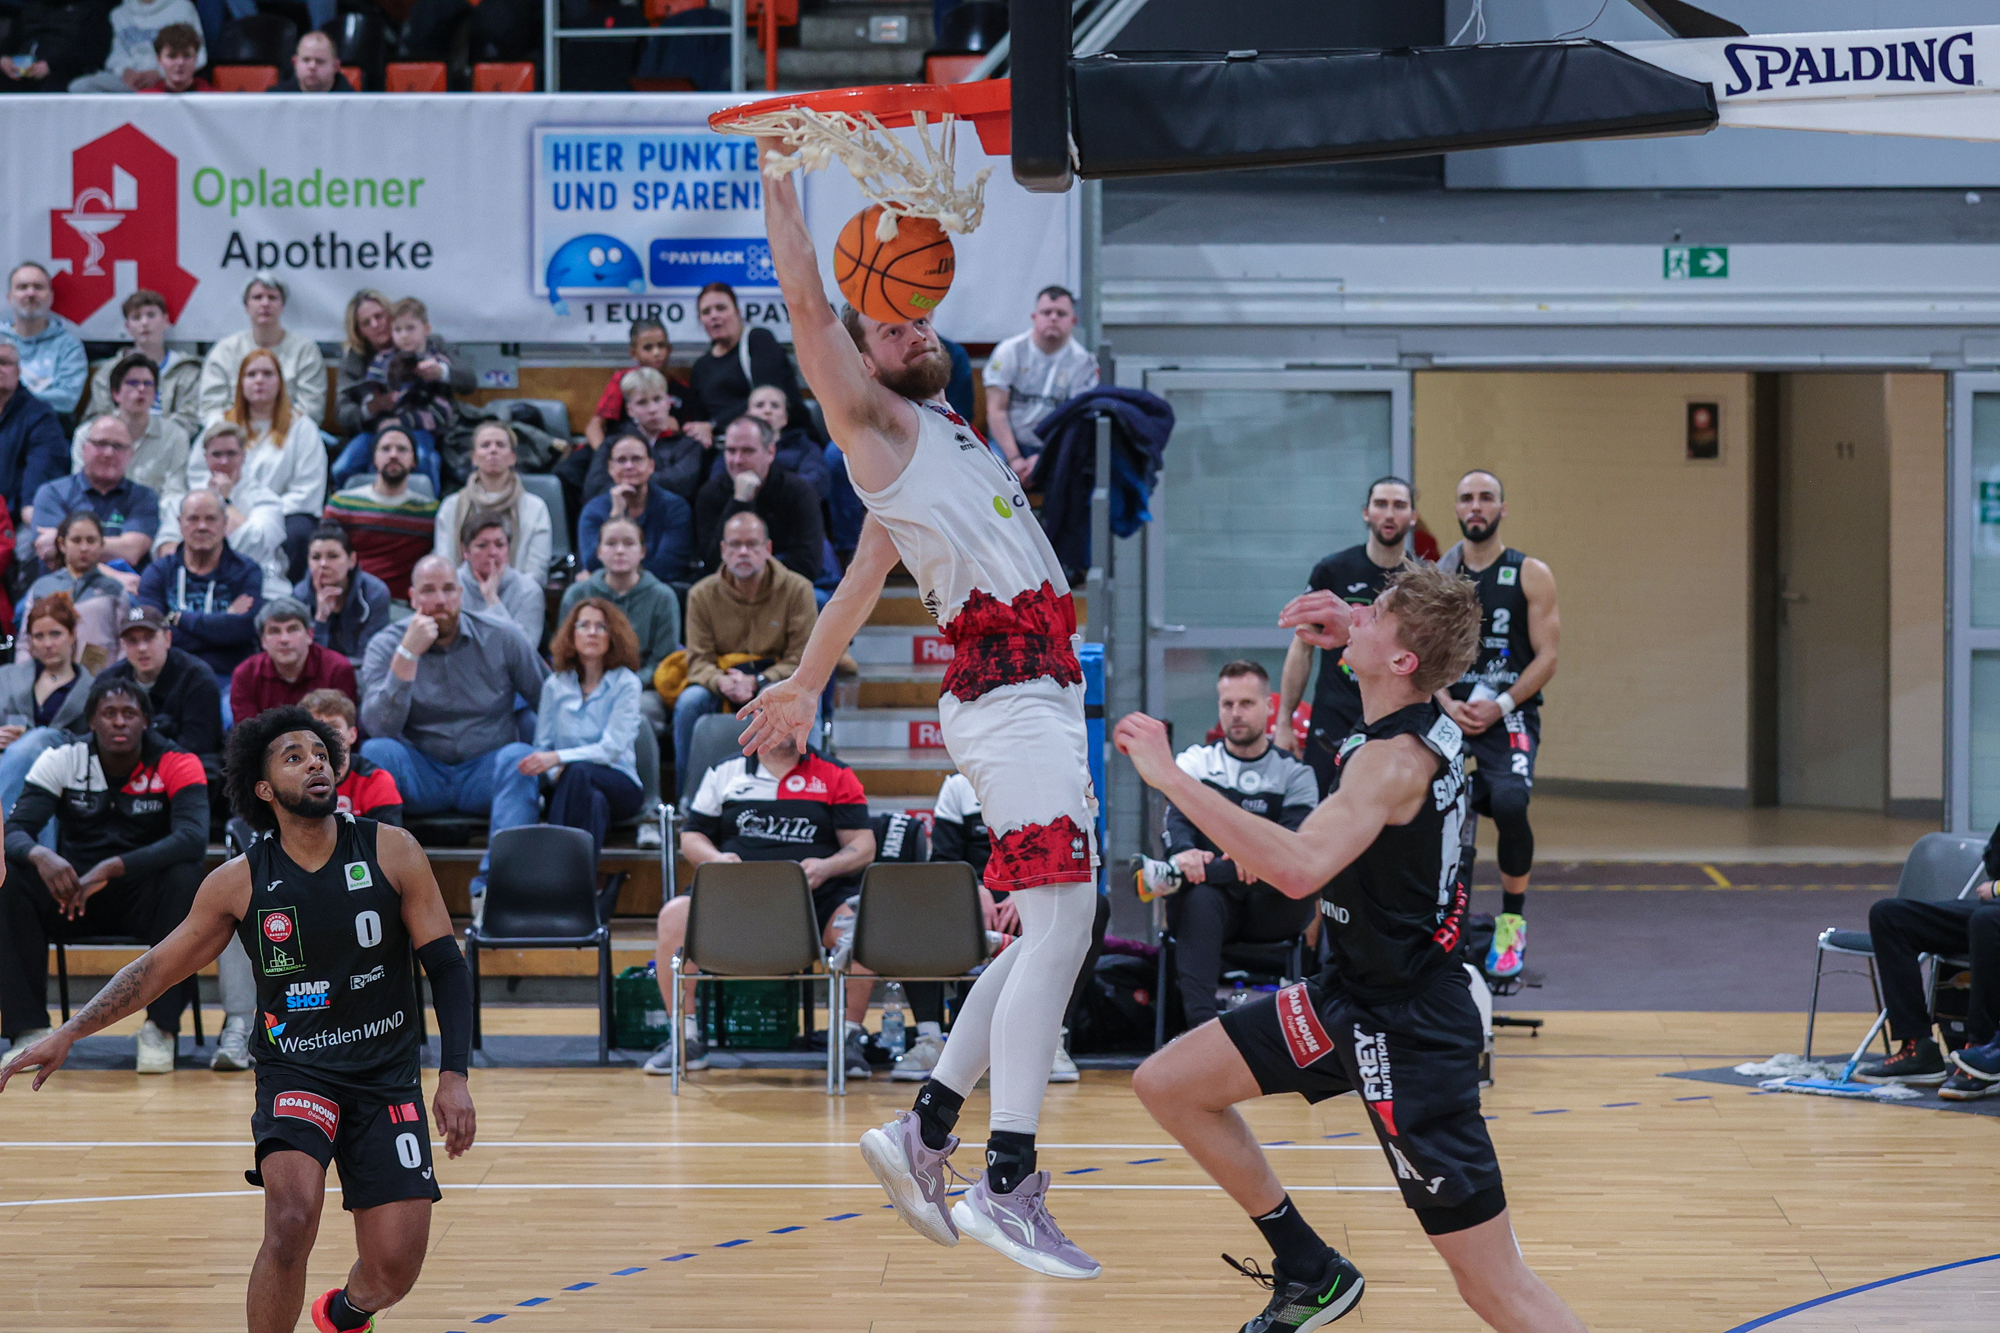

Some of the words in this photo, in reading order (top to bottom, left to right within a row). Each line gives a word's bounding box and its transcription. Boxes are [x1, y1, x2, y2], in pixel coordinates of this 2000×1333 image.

[1724, 31, 1976, 97] SPALDING
[554, 142, 623, 171] HIER
[193, 167, 426, 217] Opladener
[554, 181, 617, 210] UND
[633, 181, 761, 210] SPAREN!
[221, 231, 434, 269] Apotheke
[666, 250, 745, 264] PAYBACK
[585, 305, 594, 322] 1
[1492, 608, 1510, 634] 2
[1512, 752, 1529, 776] 2
[355, 910, 382, 948] 0
[285, 981, 330, 996] JUMP
[286, 993, 331, 1009] SHOT.
[278, 1010, 404, 1054] WestfalenWIND
[1294, 1015, 1321, 1054] HOUSE
[1353, 1029, 1382, 1101] FREY
[1376, 1032, 1394, 1100] NUTRITION
[279, 1097, 311, 1109] ROAD
[312, 1102, 337, 1124] HOUSE
[395, 1132, 422, 1169] 0
